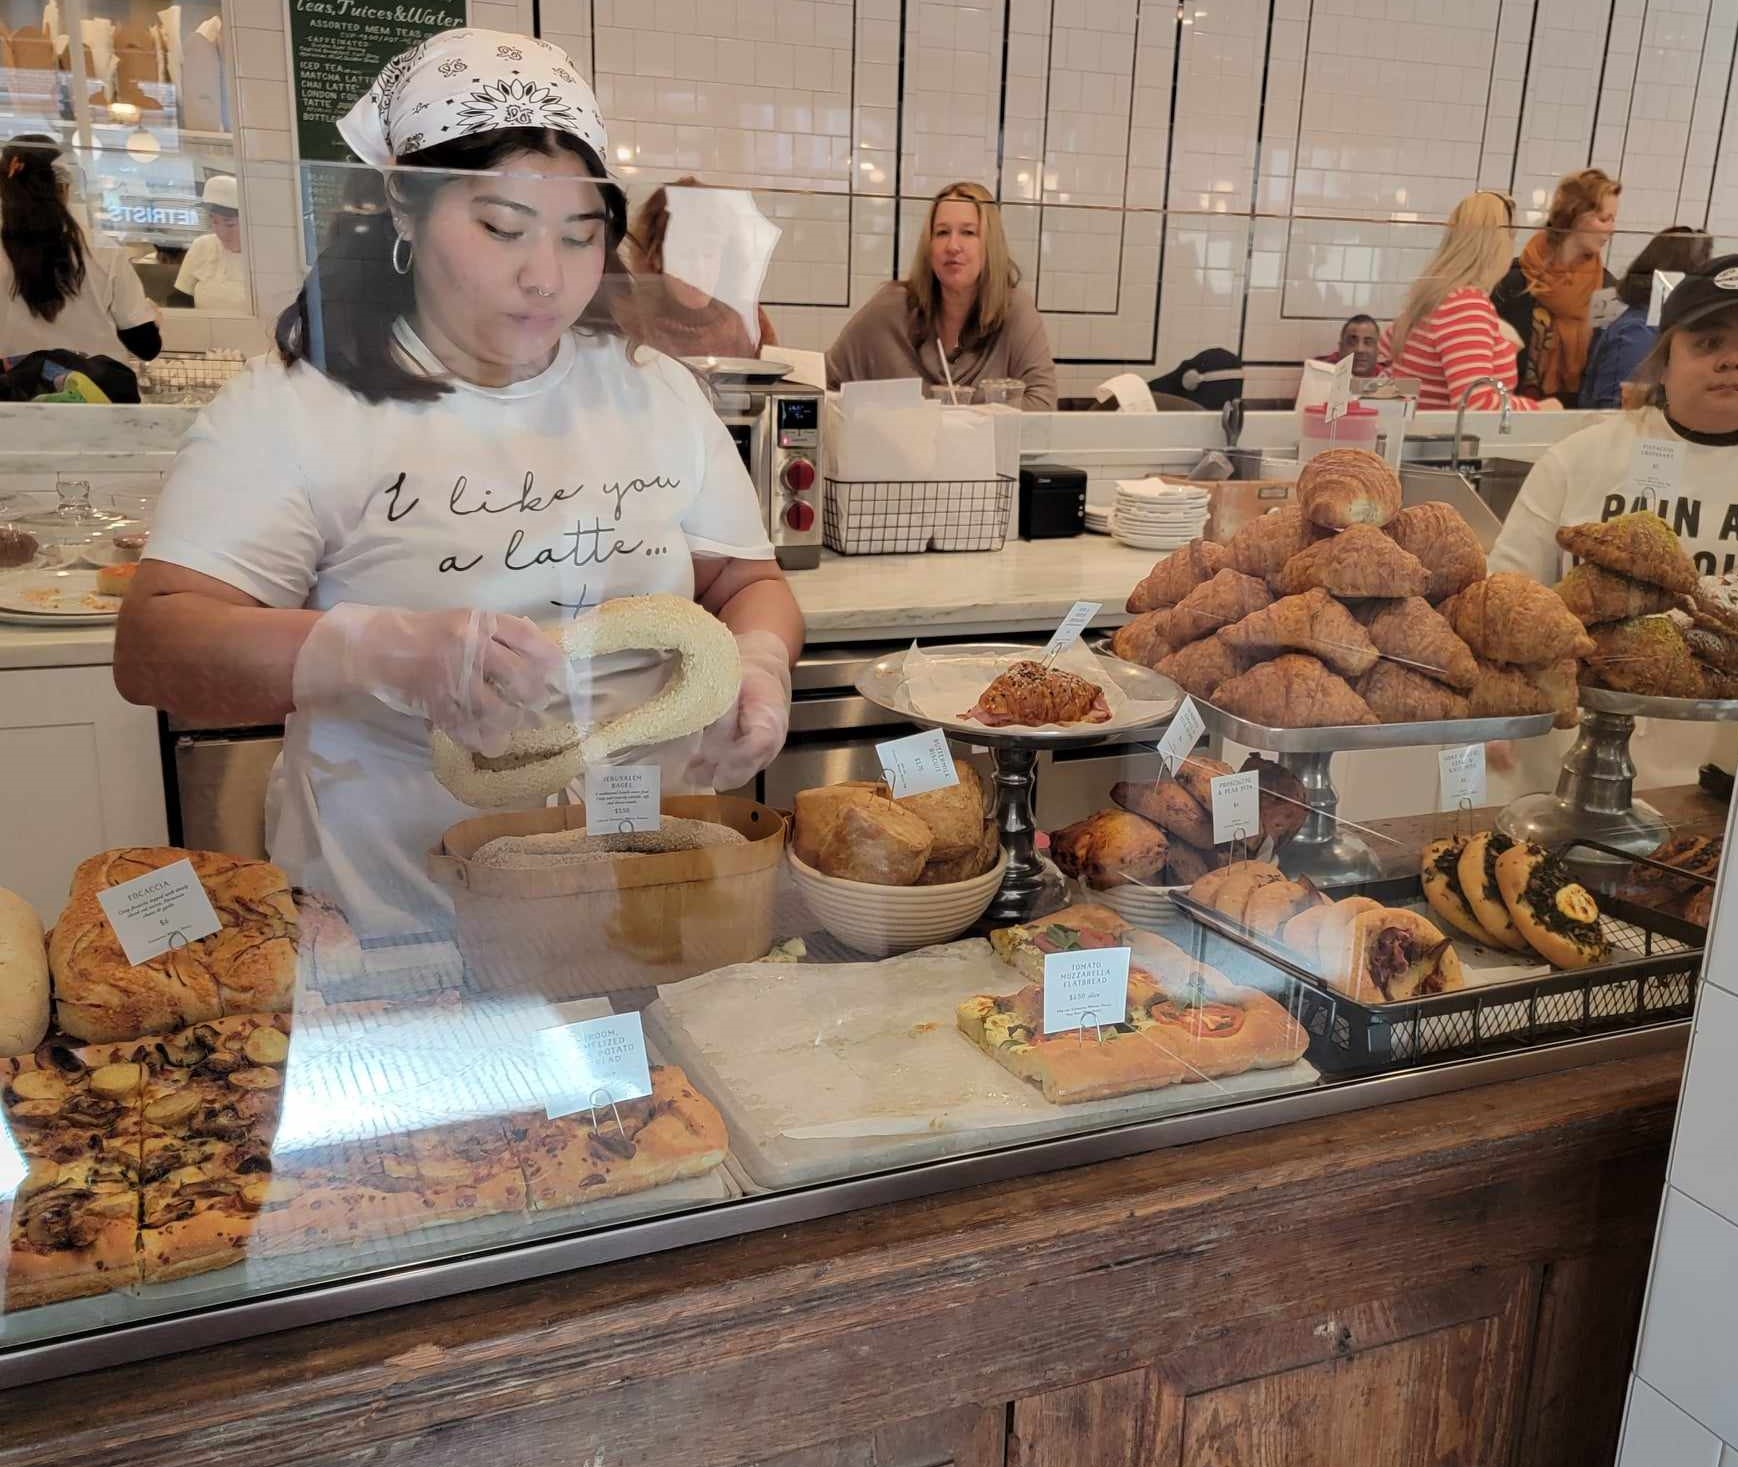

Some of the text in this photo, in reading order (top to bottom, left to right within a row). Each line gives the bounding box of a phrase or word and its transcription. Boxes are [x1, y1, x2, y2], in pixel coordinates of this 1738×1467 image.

[310, 19, 360, 32] ASSORTED
[300, 71, 341, 81] MATCHA
[450, 471, 584, 516] like
[603, 476, 681, 521] you
[438, 554, 484, 573] a
[602, 775, 642, 783] JERUSALEM
[127, 880, 171, 902] FOCACCIA
[1072, 961, 1102, 971] TOMATO
[1060, 969, 1110, 980] MOZZARELLA
[1063, 977, 1108, 988] FLATBREAD
